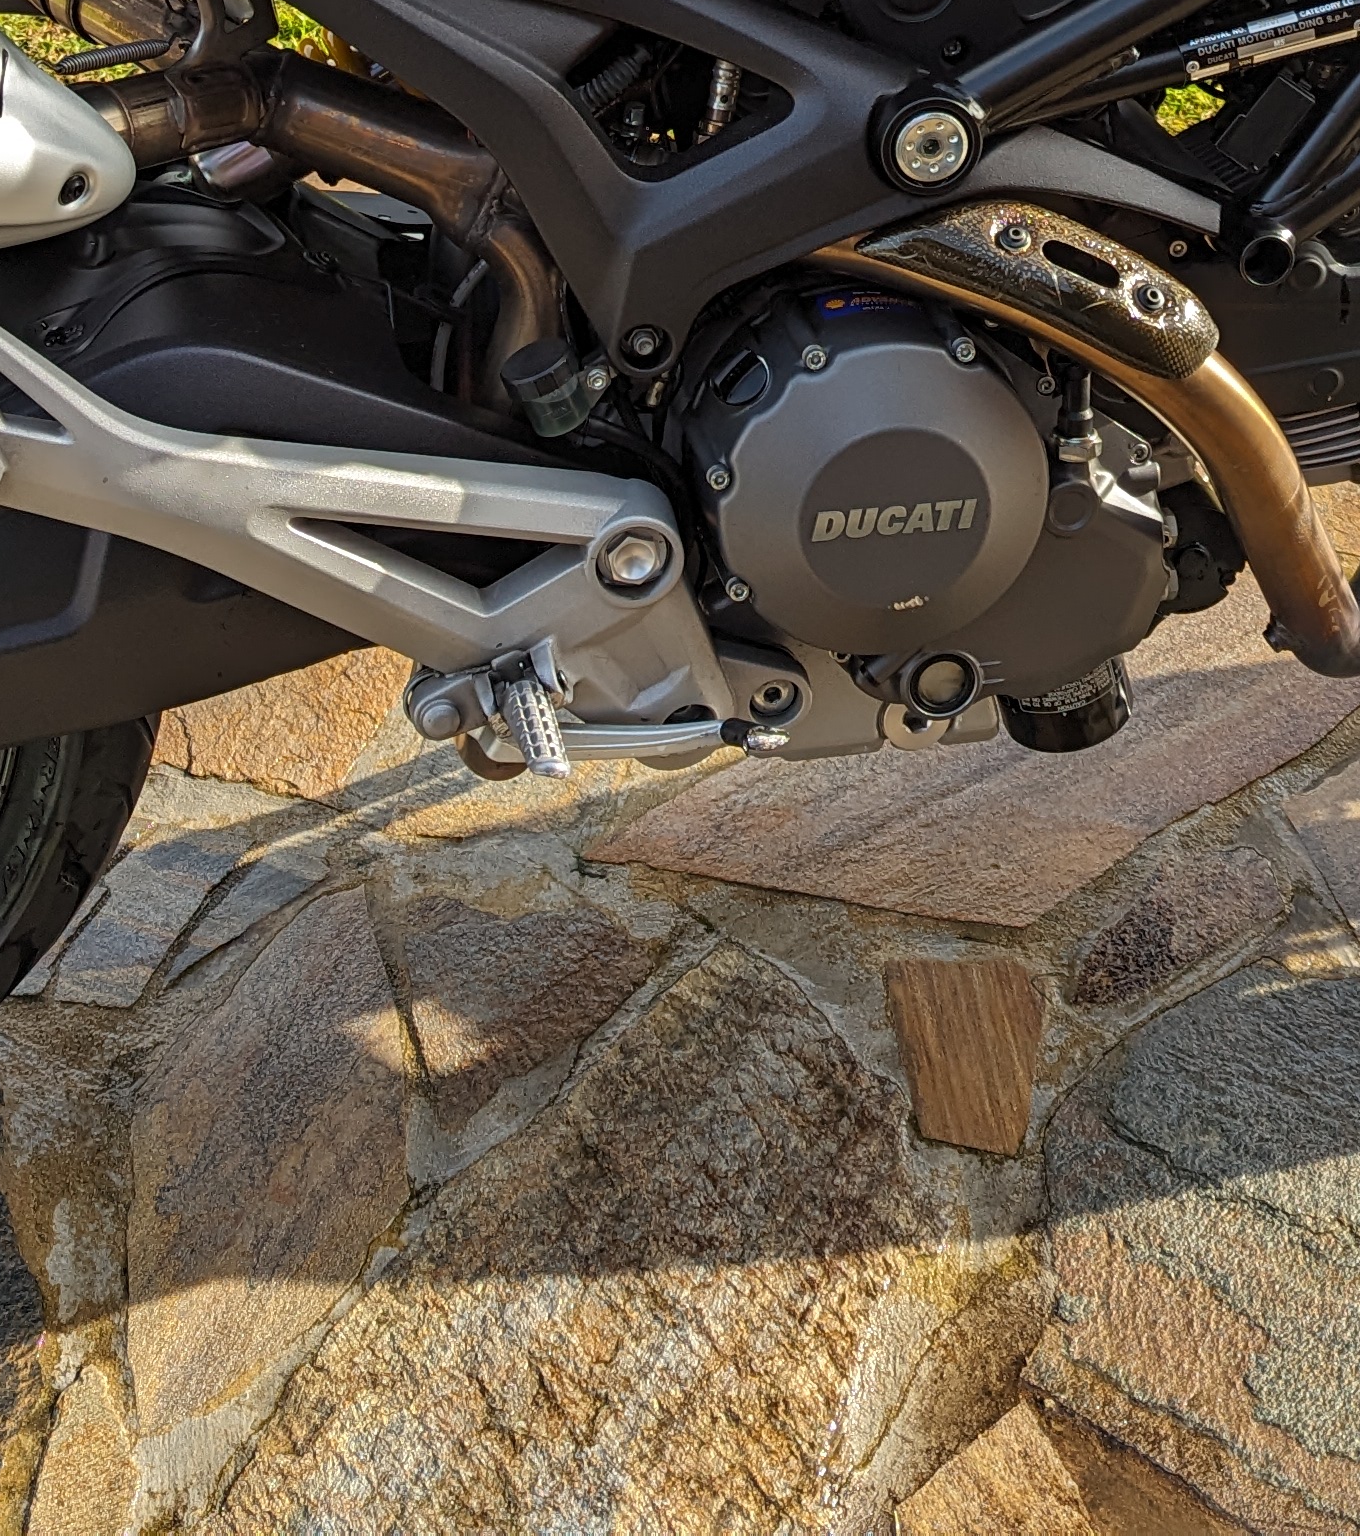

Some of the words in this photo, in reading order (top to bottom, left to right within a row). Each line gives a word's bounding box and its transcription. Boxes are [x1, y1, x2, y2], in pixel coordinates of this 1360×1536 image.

[1299, 0, 1341, 18] CATEGORY
[1189, 30, 1231, 46] APPROVAL
[1197, 39, 1236, 56] DUCATI
[1237, 30, 1275, 45] MOTOR
[1277, 16, 1324, 35] HOLDING
[1207, 52, 1236, 64] DUCATI
[811, 498, 978, 543] DUCATI
